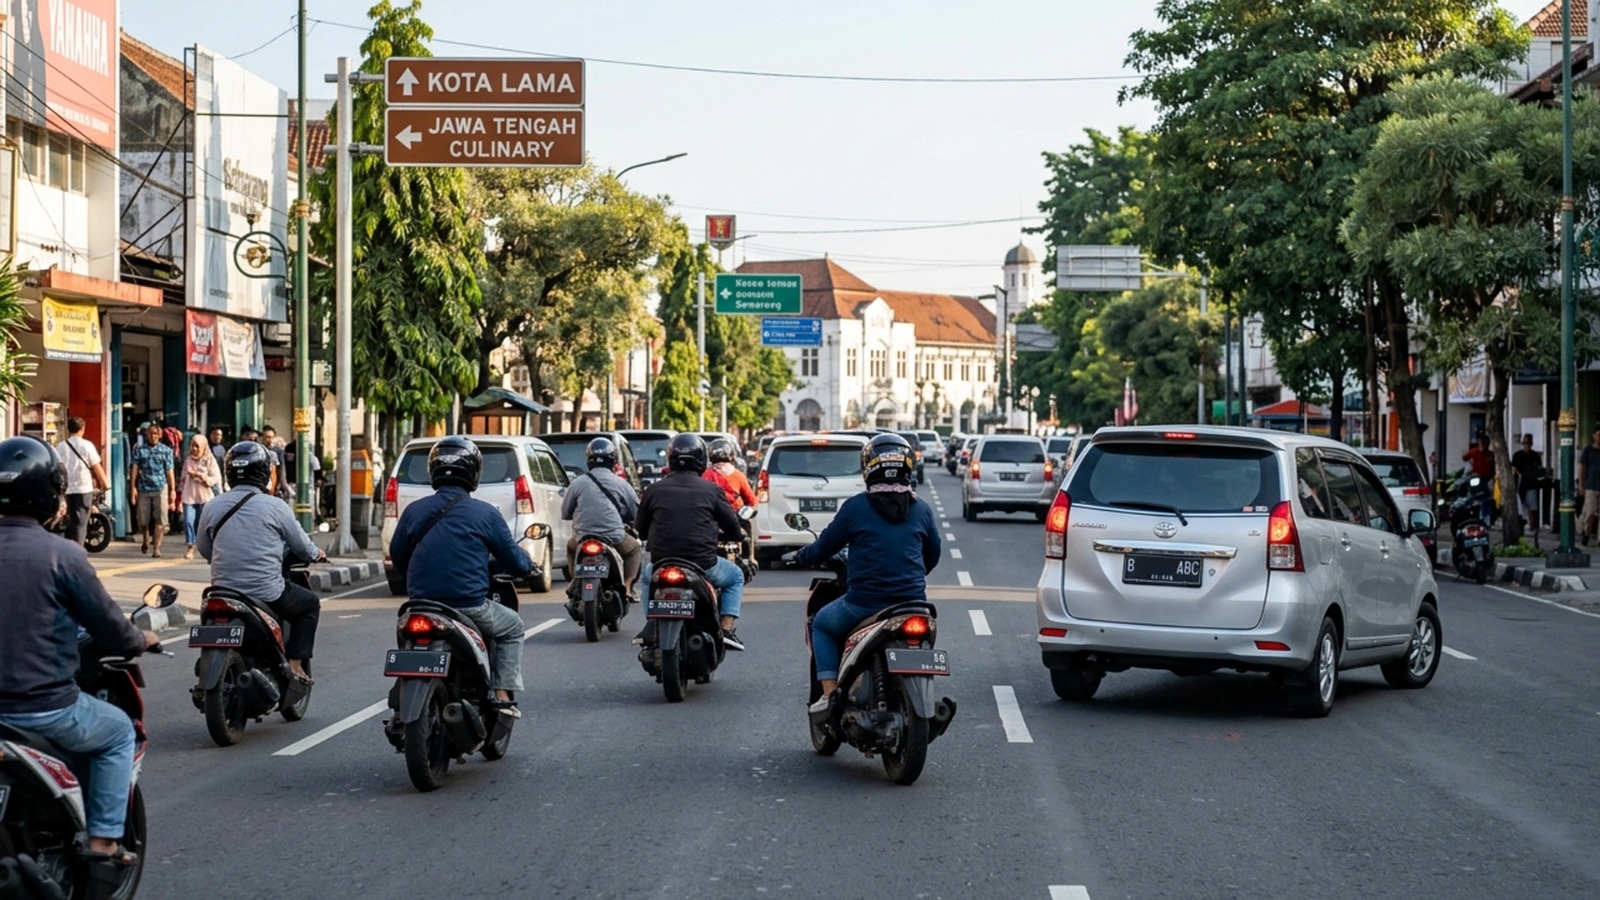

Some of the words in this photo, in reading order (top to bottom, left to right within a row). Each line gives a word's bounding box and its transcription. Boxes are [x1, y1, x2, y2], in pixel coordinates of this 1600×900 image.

[428, 72, 493, 93] KOTA
[501, 73, 575, 93] LAMA
[428, 117, 486, 135] JAWA
[493, 118, 576, 135] TENGAH
[449, 141, 555, 158] CULINARY
[1127, 558, 1136, 572] B
[1176, 560, 1200, 576] ABC
